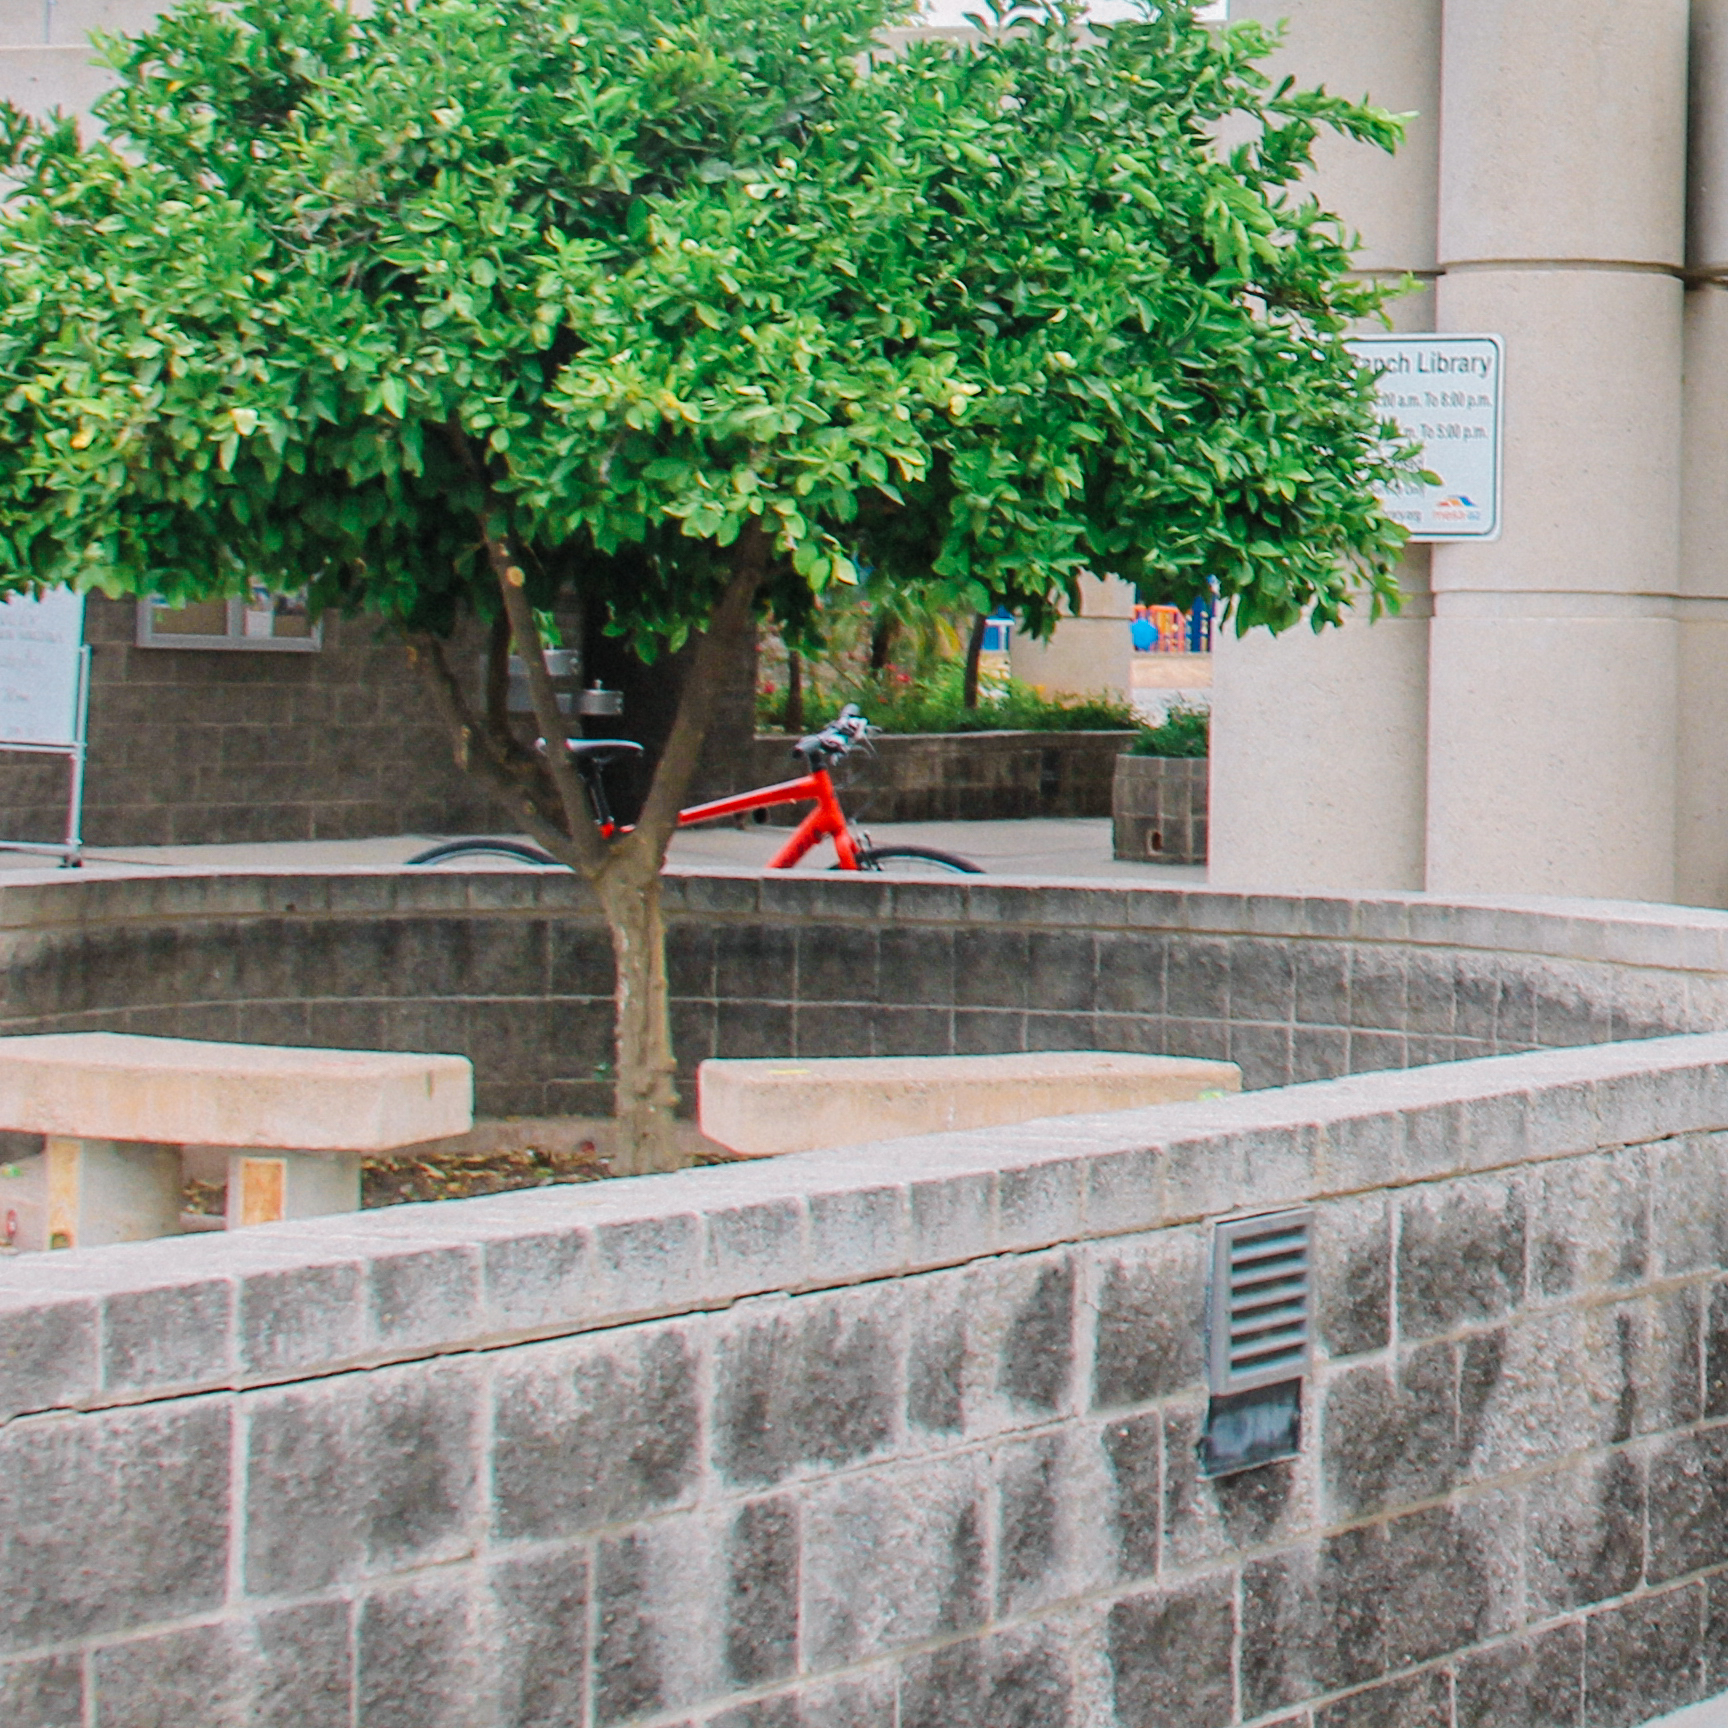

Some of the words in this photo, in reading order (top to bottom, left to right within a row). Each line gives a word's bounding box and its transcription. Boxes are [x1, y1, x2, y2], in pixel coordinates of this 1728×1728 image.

[1417, 351, 1492, 378] Library
[1424, 391, 1439, 408] To
[1467, 394, 1493, 411] p.m.
